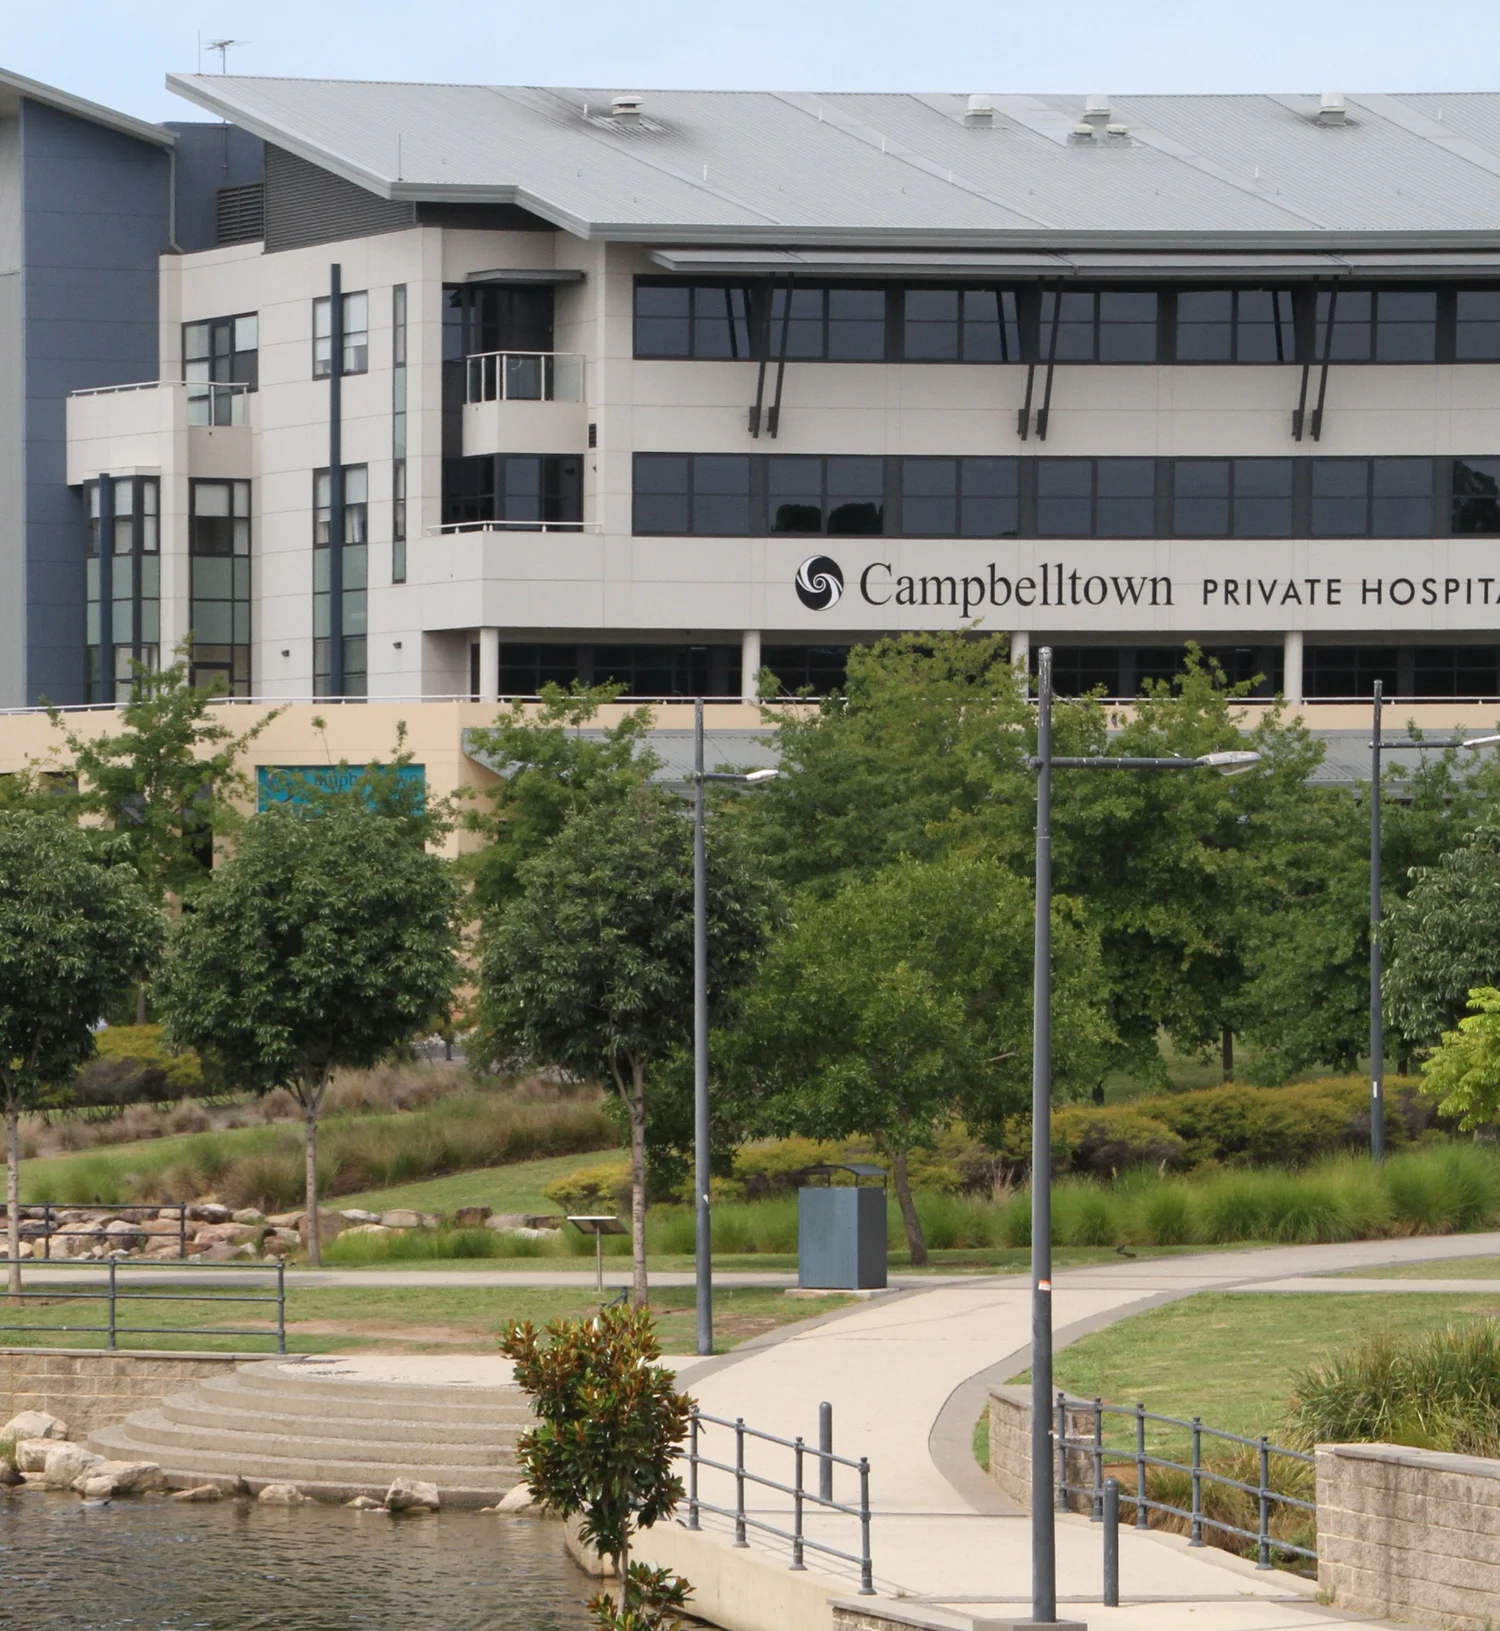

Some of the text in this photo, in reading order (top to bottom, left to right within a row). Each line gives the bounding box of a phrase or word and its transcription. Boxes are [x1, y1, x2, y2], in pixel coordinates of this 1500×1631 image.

[860, 562, 1500, 618] Campbelltown PRIVATE HOSPIT
